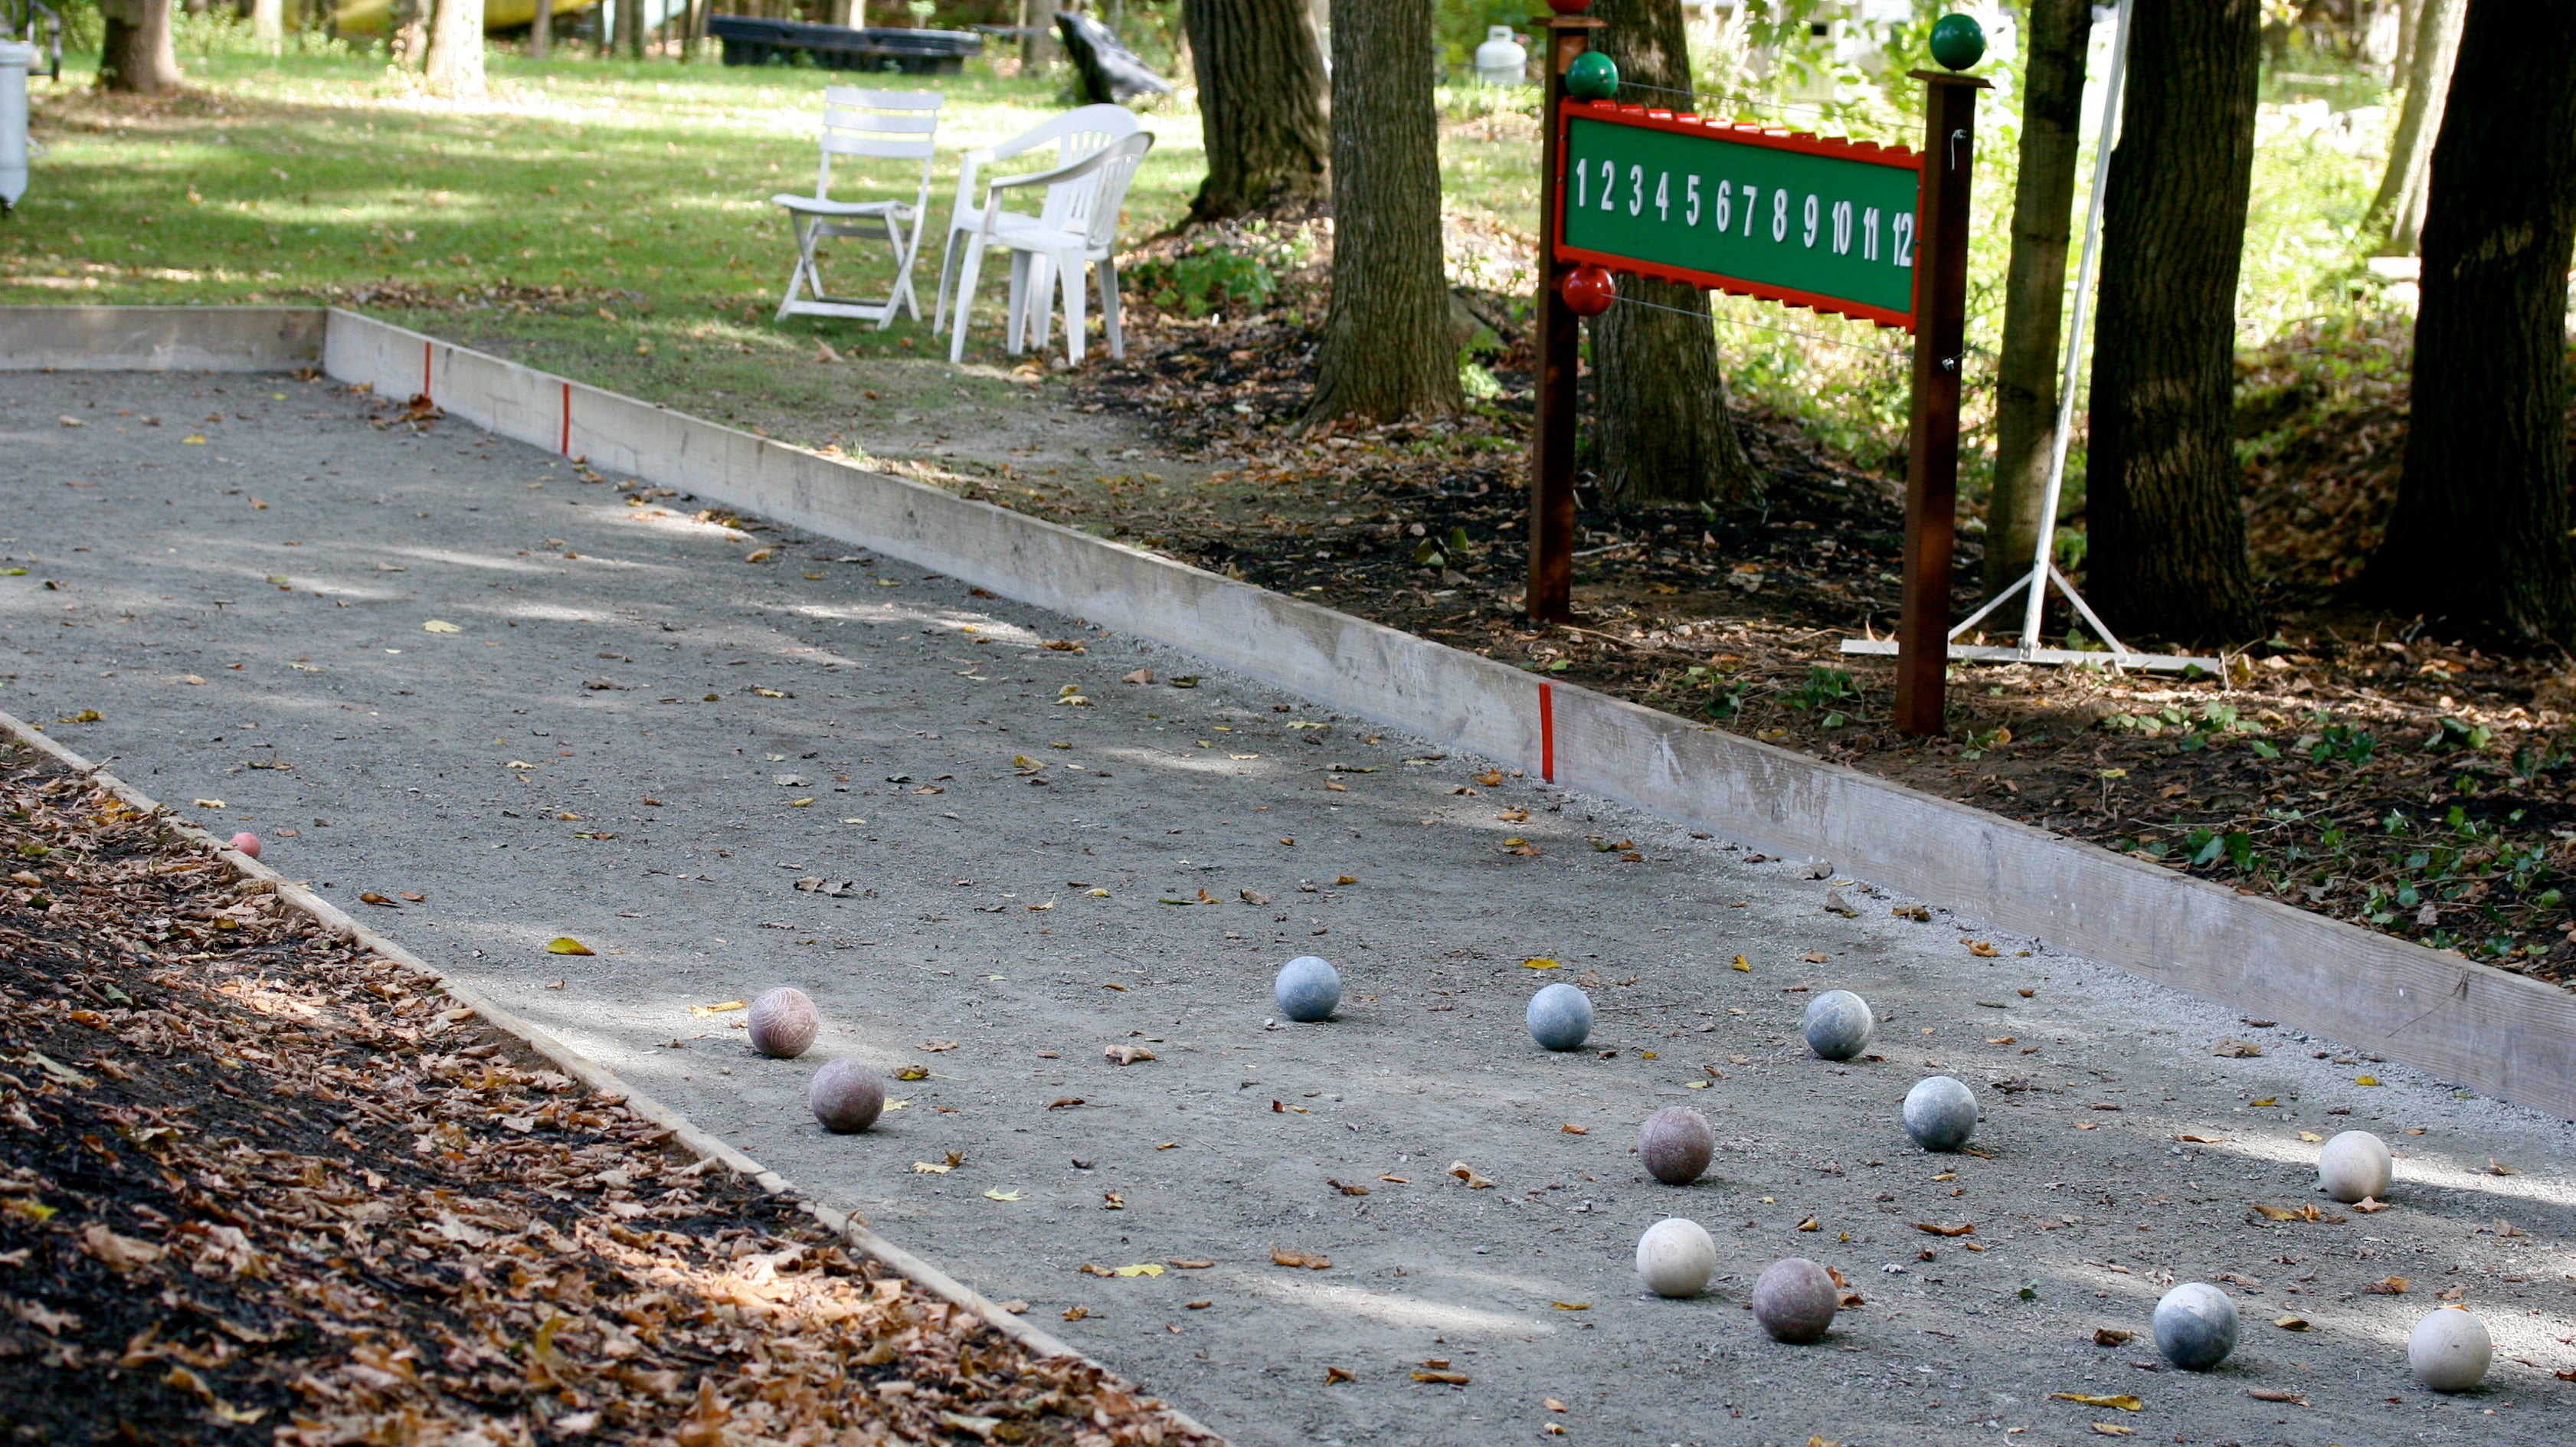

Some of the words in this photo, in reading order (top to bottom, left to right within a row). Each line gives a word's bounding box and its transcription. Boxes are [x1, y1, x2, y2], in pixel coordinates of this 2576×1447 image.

[1576, 158, 1587, 207] 1
[1601, 160, 1615, 211] 2
[1629, 165, 1643, 217] 3
[1655, 172, 1669, 221] 4
[1686, 175, 1700, 226] 5
[1717, 180, 1731, 232] 6
[1743, 185, 1757, 237] 7
[1772, 188, 1788, 242] 8
[1803, 194, 1819, 248] 9
[1832, 201, 1852, 255] 10
[1863, 207, 1880, 261] 11
[1893, 212, 1914, 267] 12
